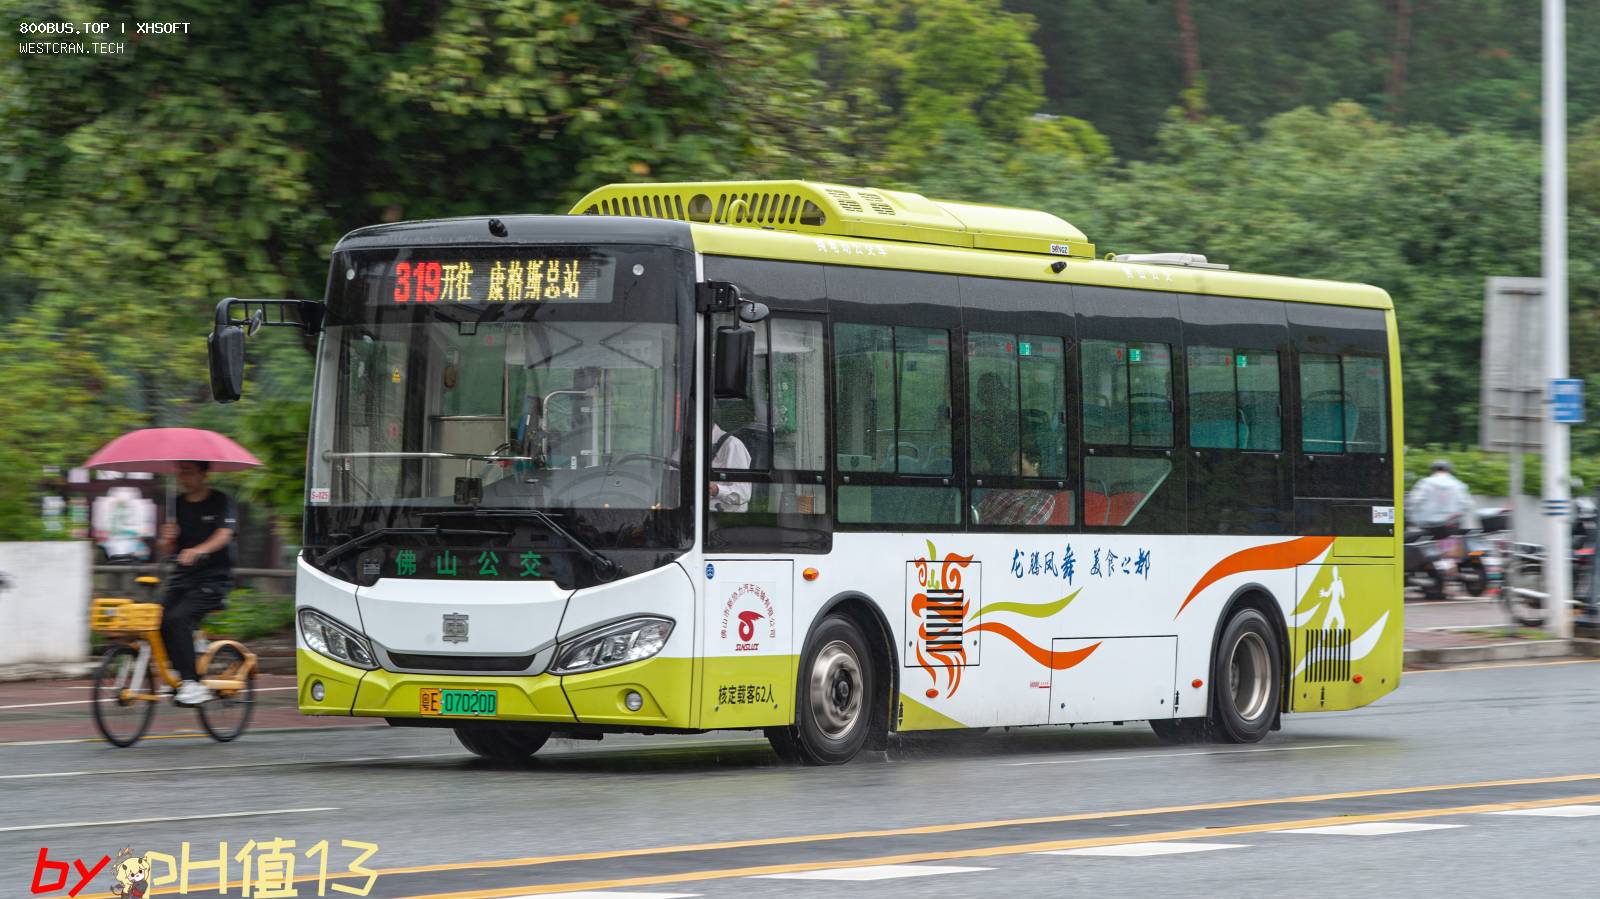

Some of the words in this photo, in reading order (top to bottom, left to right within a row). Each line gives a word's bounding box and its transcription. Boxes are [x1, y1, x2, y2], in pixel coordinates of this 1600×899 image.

[394, 262, 441, 303] 319
[488, 260, 580, 301] 康格斯总站
[395, 549, 542, 577] 佛山公交
[1011, 543, 1076, 586] 龙腾凤舞
[1090, 547, 1151, 581] 美食之都
[718, 683, 775, 705] 核定载客62人
